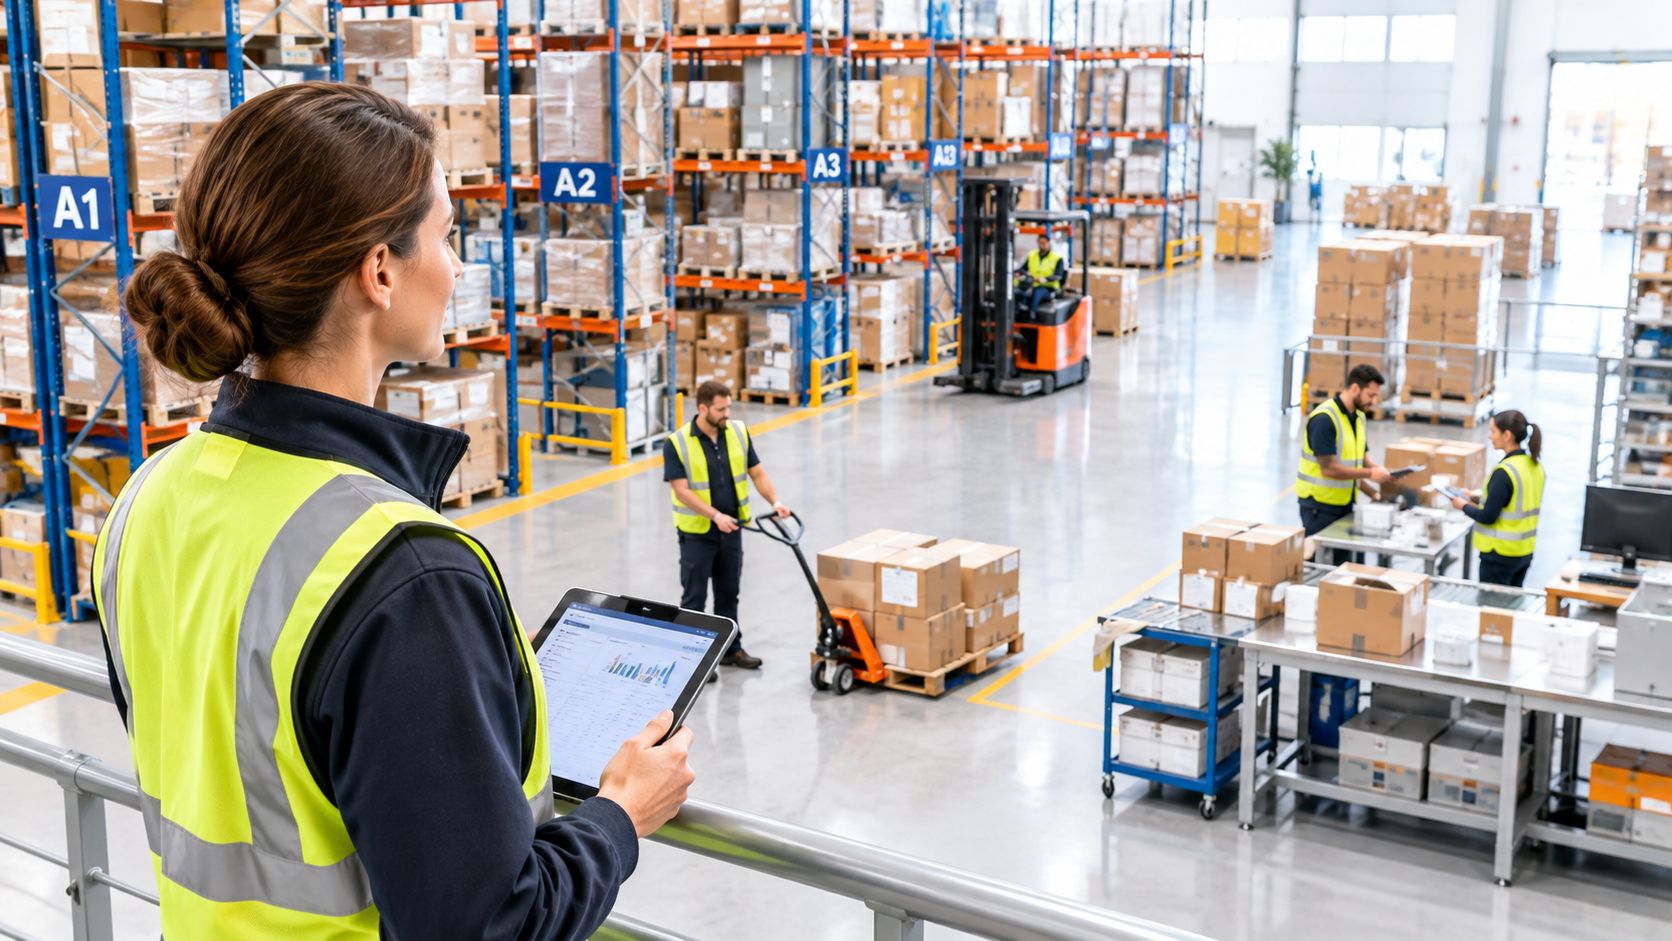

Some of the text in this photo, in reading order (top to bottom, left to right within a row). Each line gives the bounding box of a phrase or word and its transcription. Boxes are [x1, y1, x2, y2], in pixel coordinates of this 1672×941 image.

[813, 152, 841, 179] A3
[553, 167, 597, 198] A2
[53, 186, 99, 230] A1
